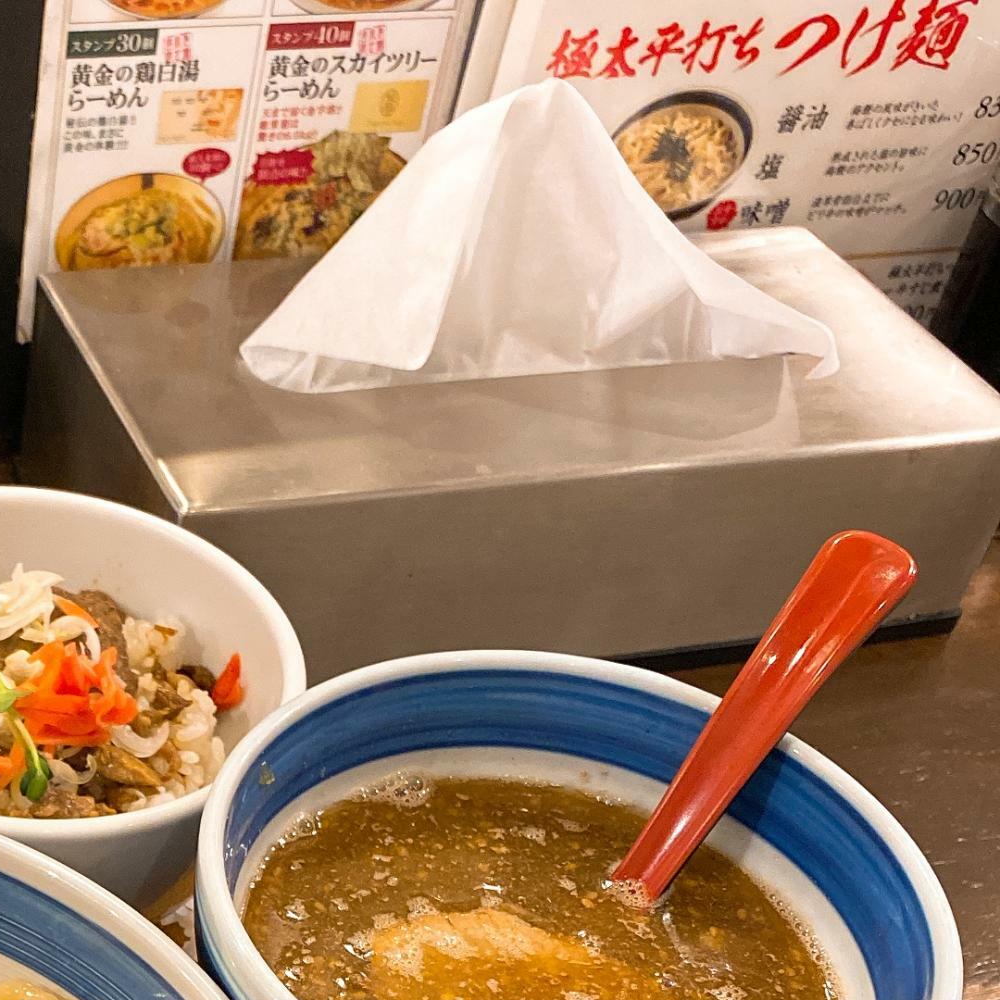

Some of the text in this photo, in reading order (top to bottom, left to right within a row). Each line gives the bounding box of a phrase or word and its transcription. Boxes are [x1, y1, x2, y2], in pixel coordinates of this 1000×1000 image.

[71, 59, 200, 88] 黄金の鶏白湯
[268, 50, 438, 79] 黄金のスカイツリー
[68, 87, 149, 112] らーめん
[263, 79, 342, 102] らーめん
[755, 153, 784, 181] 塩
[740, 198, 791, 226] 味噌
